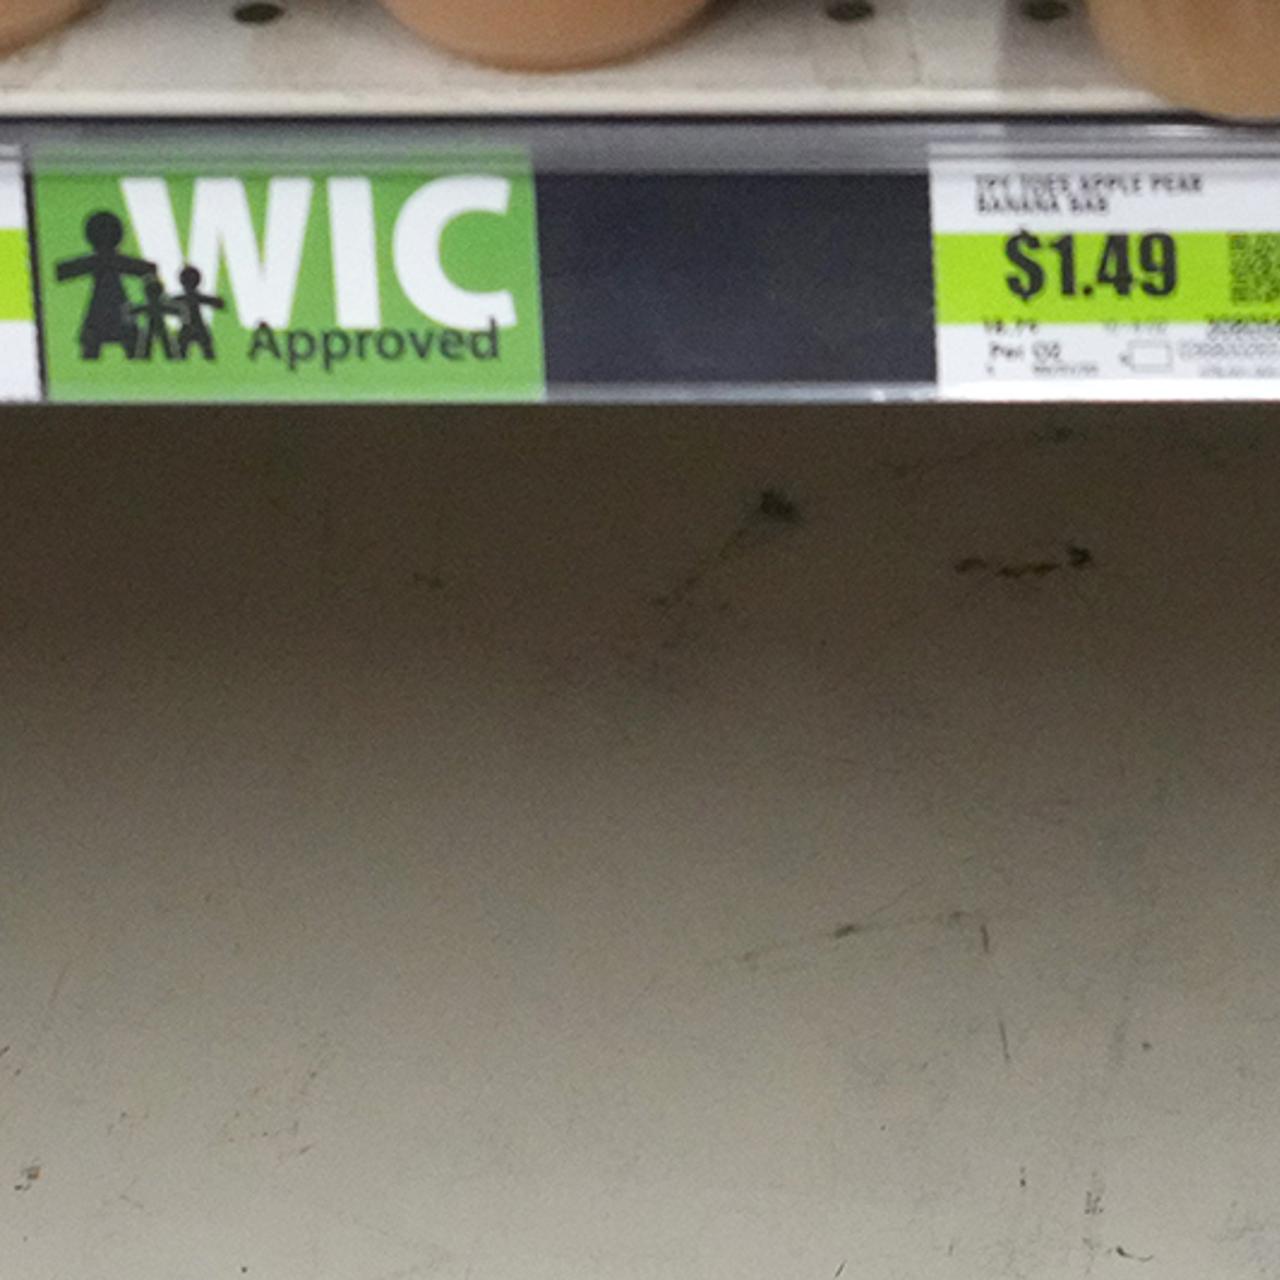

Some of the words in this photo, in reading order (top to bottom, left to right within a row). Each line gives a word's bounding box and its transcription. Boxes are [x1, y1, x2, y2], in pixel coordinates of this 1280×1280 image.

[977, 195, 1059, 213] BANANA
[1150, 173, 1202, 191] PEAR
[119, 174, 517, 330] WIC
[1004, 229, 1178, 302] $1.49
[249, 318, 499, 371] Approved
